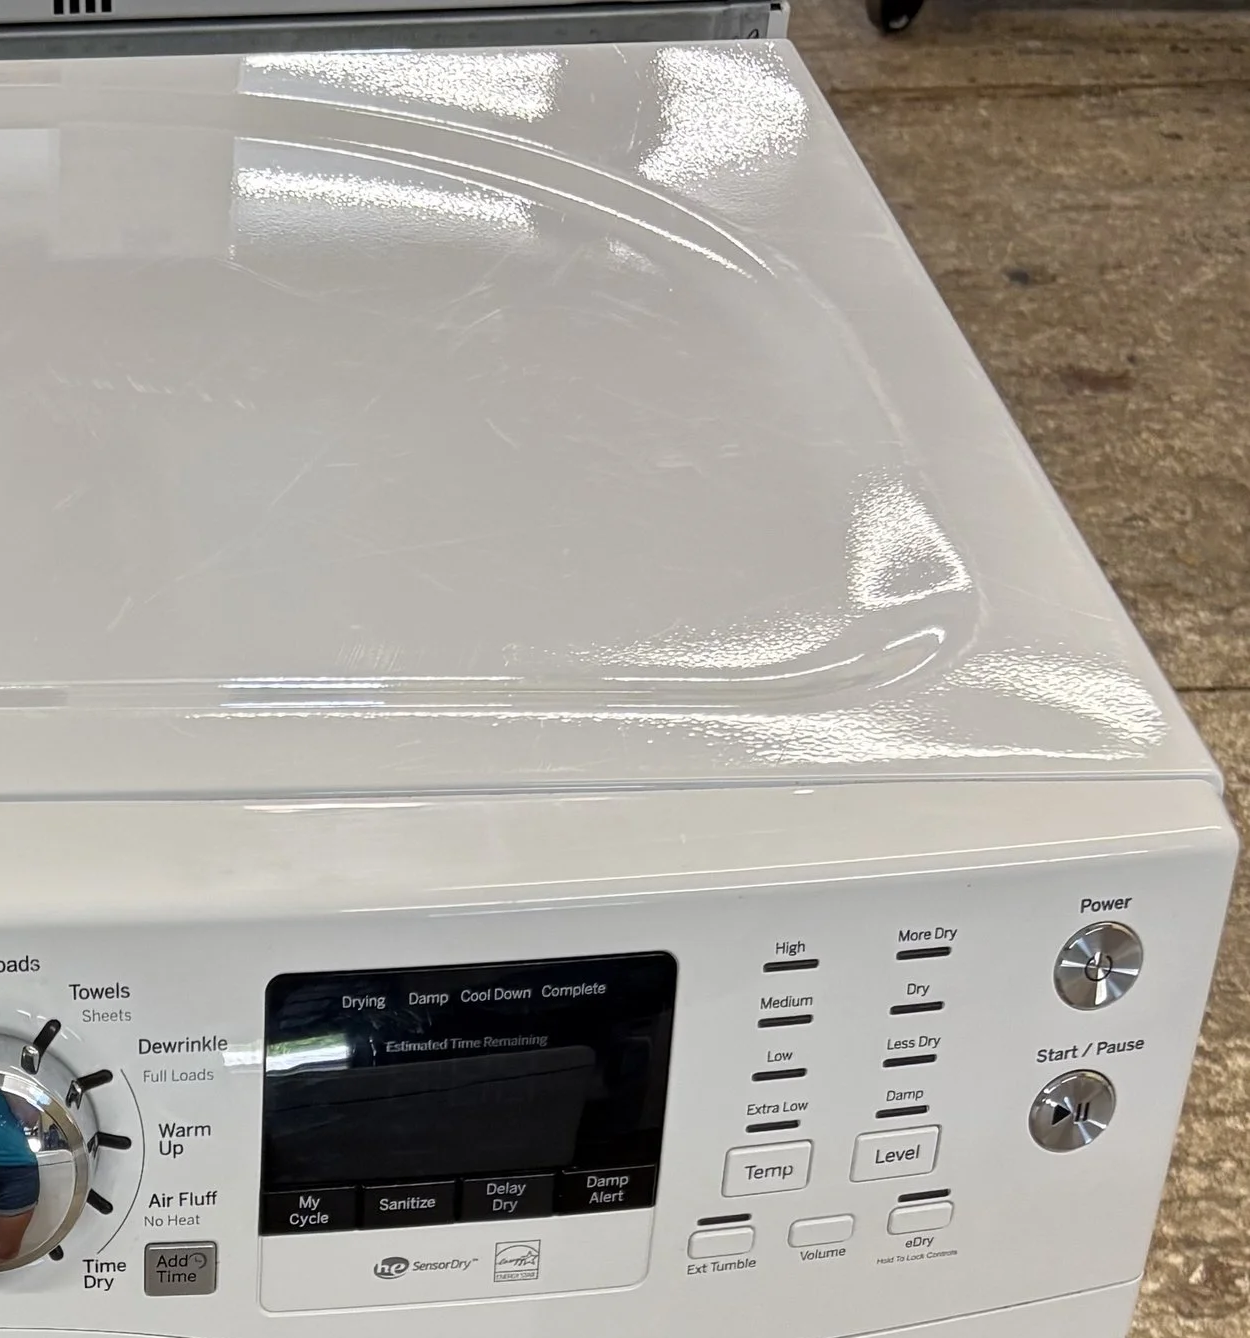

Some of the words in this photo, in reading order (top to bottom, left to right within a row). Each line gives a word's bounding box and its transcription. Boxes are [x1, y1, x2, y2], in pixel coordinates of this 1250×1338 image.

[1080, 895, 1132, 913] Power
[898, 928, 932, 942] More
[934, 926, 958, 942] Dry
[775, 940, 806, 957] High
[69, 982, 131, 1002] Towels
[460, 989, 490, 1003] Cool
[494, 987, 531, 1000] Down
[541, 982, 606, 1000] Complete
[906, 983, 930, 998] Dry
[342, 994, 386, 1010] Drying
[409, 992, 449, 1007] Damp
[760, 995, 814, 1009] Medium
[82, 1007, 132, 1023] Sheets
[138, 1036, 228, 1055] Dewrinkle
[386, 1038, 448, 1053] Estimated
[450, 1037, 481, 1049] Time
[484, 1034, 548, 1049] Remaining
[887, 1037, 916, 1051] Less
[916, 1034, 941, 1050] Dry
[1036, 1045, 1078, 1063] Start
[1081, 1043, 1092, 1059] /
[1096, 1037, 1145, 1056] Pause
[767, 1050, 793, 1063] Low
[143, 1069, 165, 1083] Full
[170, 1068, 214, 1083] Loads
[886, 1087, 924, 1104] Damp
[747, 1103, 779, 1116] Extra
[782, 1100, 808, 1114] Low
[158, 1122, 212, 1138] Warm
[158, 1139, 184, 1159] Up
[875, 1145, 920, 1164] Level
[745, 1163, 794, 1180] Temp
[586, 1174, 629, 1189] Damp
[486, 1182, 526, 1198] Delay
[590, 1189, 624, 1204] Alert
[148, 1193, 173, 1209] Air
[178, 1190, 217, 1207] Fluff
[299, 1196, 320, 1212] My
[379, 1197, 435, 1211] Sanitize
[492, 1198, 518, 1214] Dry
[144, 1215, 163, 1228] No
[167, 1213, 200, 1226] Heat
[289, 1211, 329, 1227] Cycle
[905, 1235, 934, 1250] eDry
[156, 1253, 188, 1269] Add
[800, 1246, 846, 1261] Volume
[82, 1258, 126, 1275] Time
[687, 1262, 707, 1275] Ext
[709, 1258, 756, 1273] Tumble
[83, 1274, 115, 1292] Dry
[156, 1269, 197, 1284] Time
